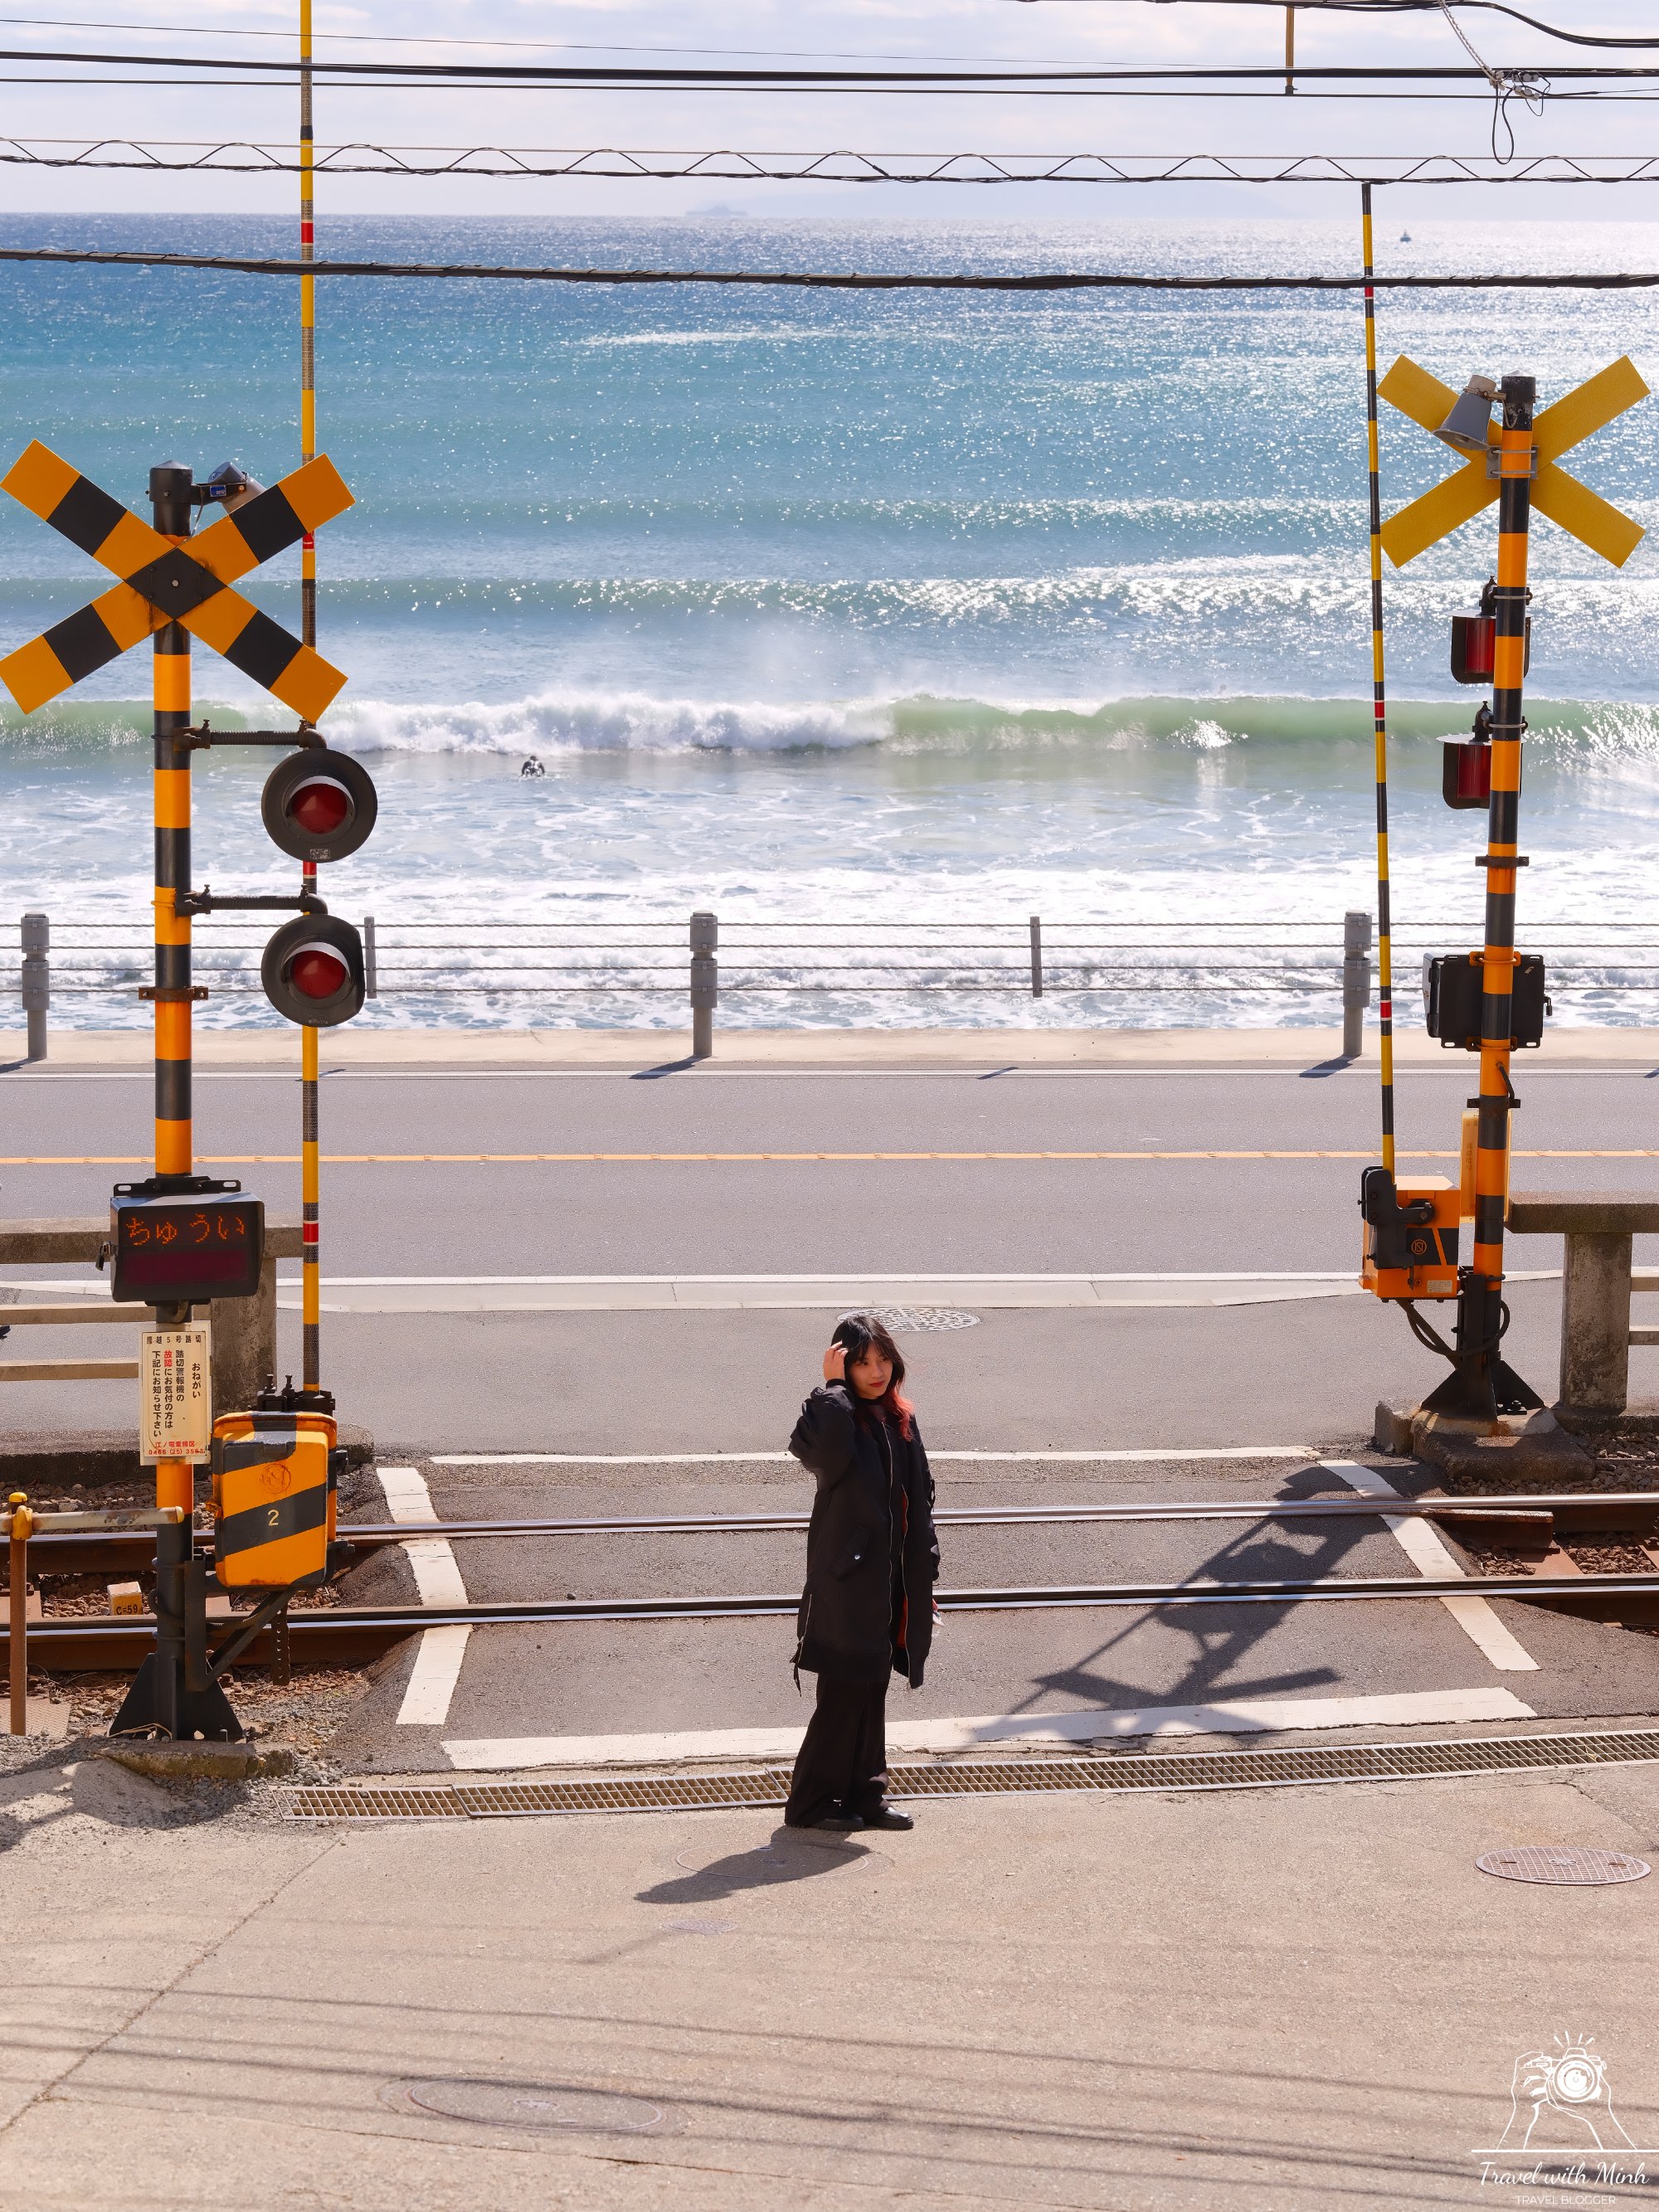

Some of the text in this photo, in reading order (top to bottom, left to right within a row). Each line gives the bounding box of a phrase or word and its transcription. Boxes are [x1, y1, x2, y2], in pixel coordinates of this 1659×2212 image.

[125, 1213, 246, 1246] ちゅうい
[152, 1350, 162, 1437] 下記にお知らせ下さい
[163, 1350, 173, 1429] 故障にお気付の方は
[175, 1349, 185, 1402] 踏切警報機の
[192, 1363, 202, 1398] おねがい
[267, 1509, 280, 1526] 2
